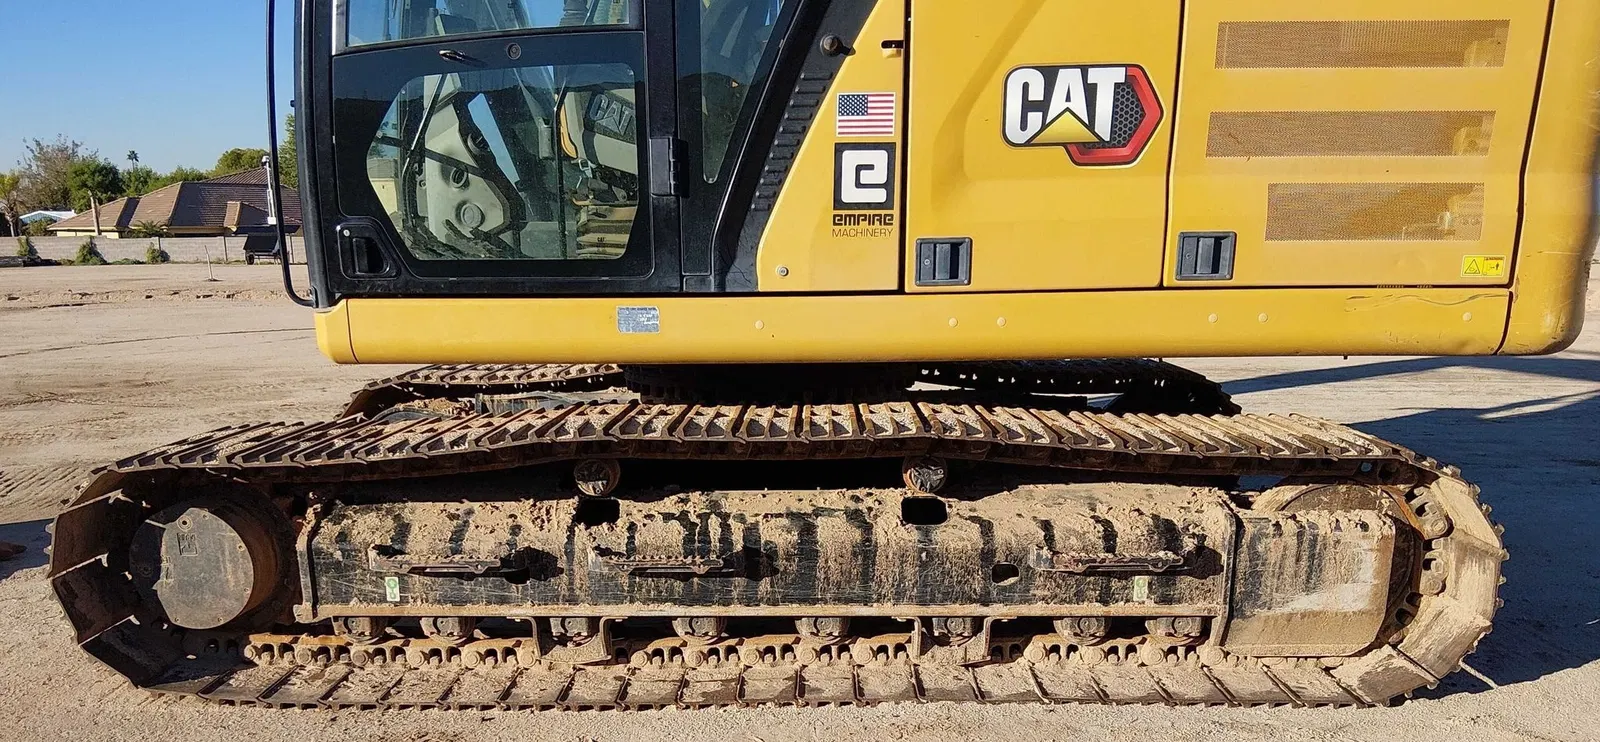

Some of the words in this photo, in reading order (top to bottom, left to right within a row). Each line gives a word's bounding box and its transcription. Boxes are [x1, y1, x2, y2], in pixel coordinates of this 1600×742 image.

[589, 93, 636, 136] CAT
[1005, 67, 1126, 144] CAT
[832, 228, 894, 238] MACHINERY
[833, 213, 894, 226] EMPIRE
